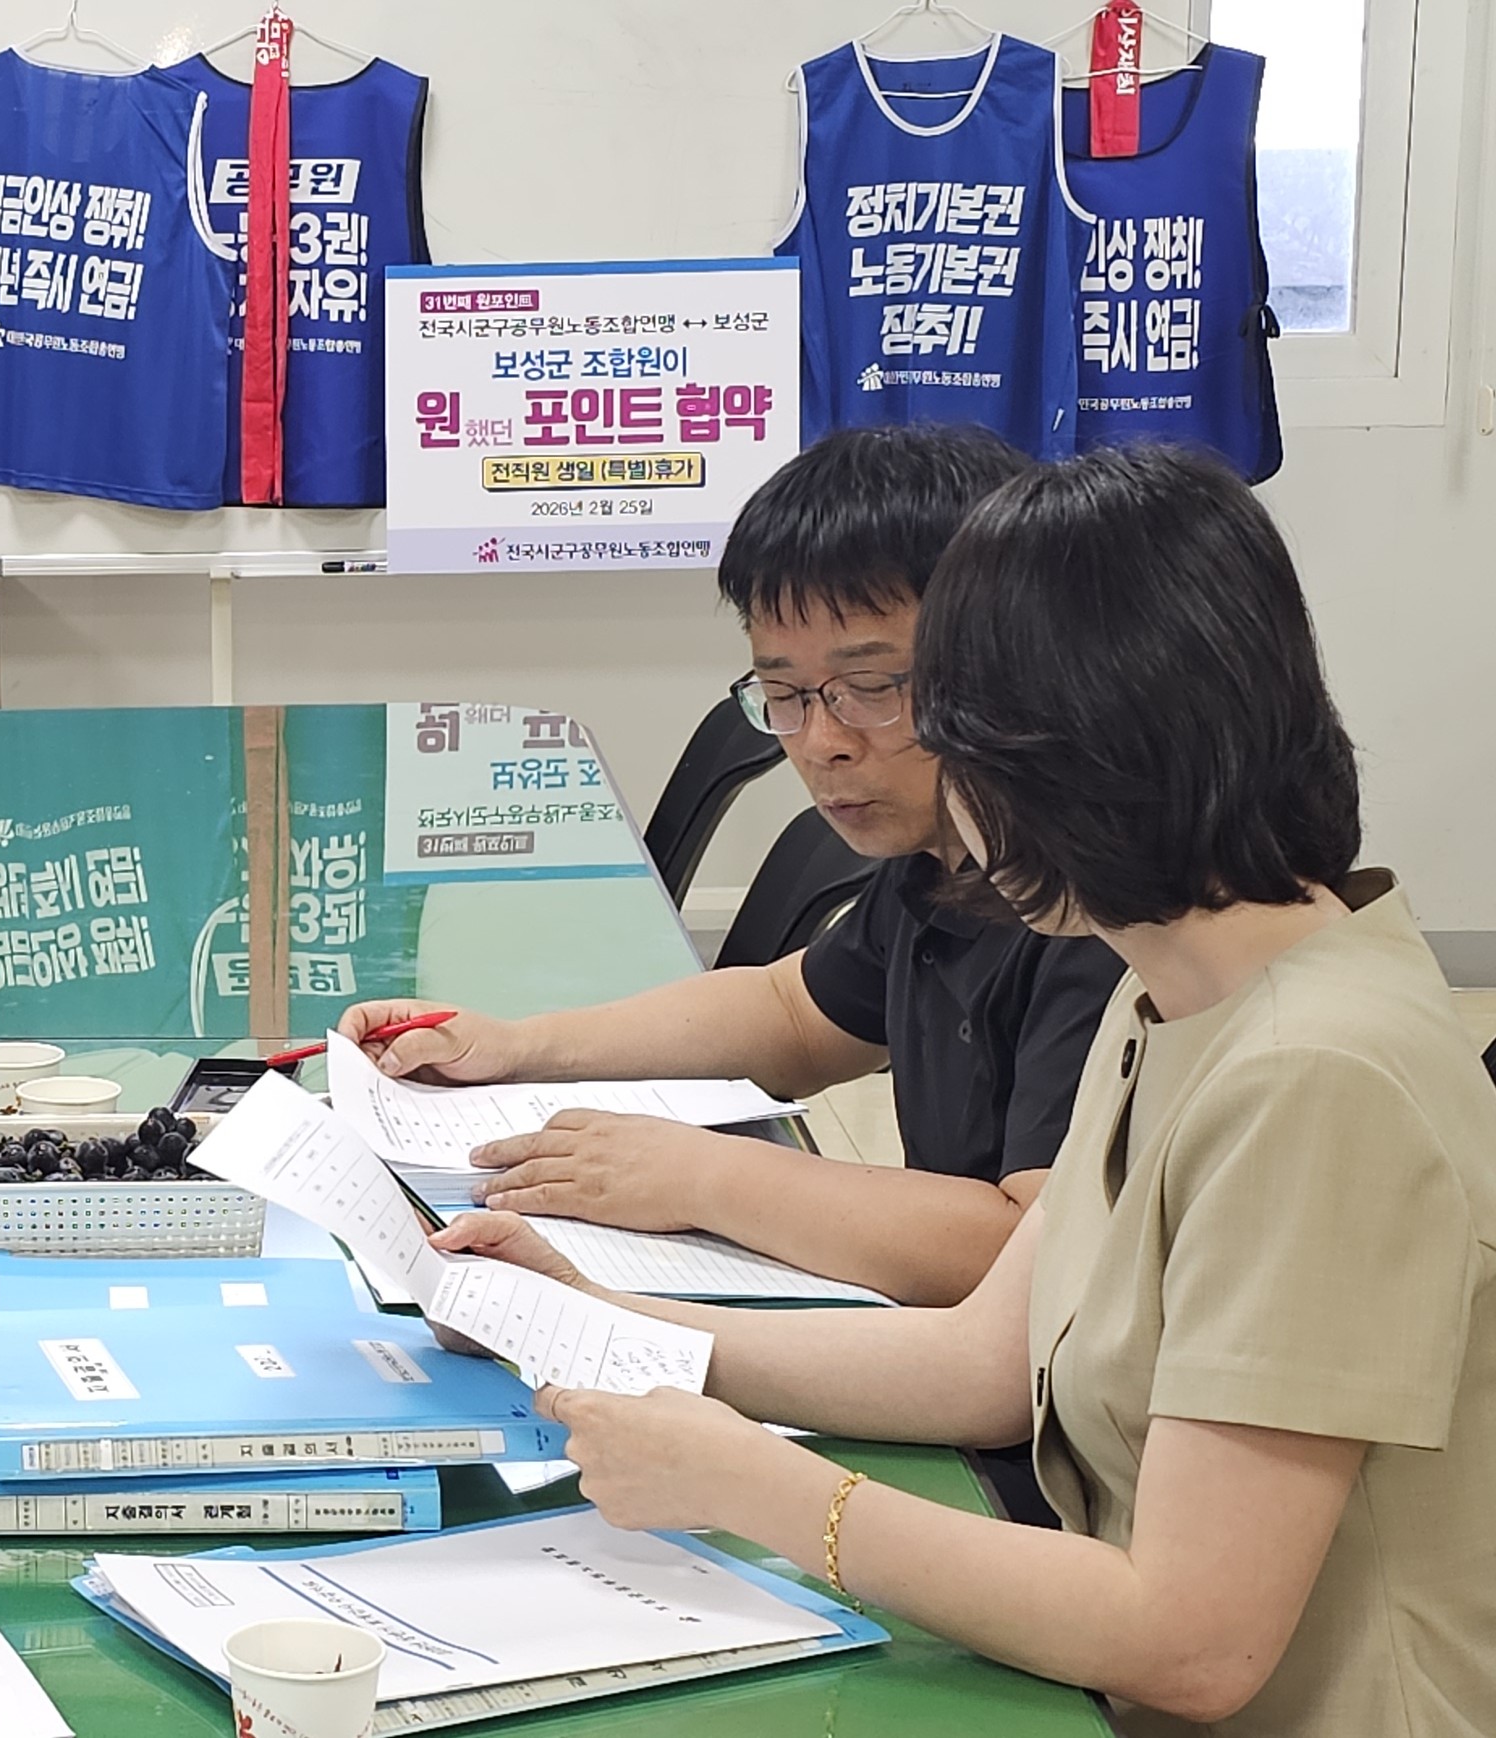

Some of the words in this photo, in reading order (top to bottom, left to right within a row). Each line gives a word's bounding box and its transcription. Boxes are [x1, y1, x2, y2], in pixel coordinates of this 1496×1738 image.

[83, 185, 152, 250] 쟁취!
[845, 182, 1027, 238] 정치기본권
[848, 243, 1022, 297] 노동기본권
[1143, 216, 1204, 290] 쟁취!
[21, 249, 78, 313] 즉시
[78, 255, 144, 320] 연금!
[288, 268, 368, 323] 자유!
[424, 294, 471, 311] 31번째
[418, 313, 676, 339] 전국시군구공무원노동조합연맹
[712, 312, 770, 332] 보성군
[880, 303, 984, 356] 쟁취!
[1082, 300, 1138, 373] 즉시
[1146, 298, 1201, 372] 연금!
[492, 350, 573, 381] 보성군
[580, 346, 688, 379] 조합원이
[524, 387, 664, 447] 포인트
[675, 382, 773, 443] 협약
[491, 461, 551, 483] 전직원
[556, 460, 595, 482] 생일
[531, 501, 583, 517] 2026년
[589, 500, 613, 517] 2월
[620, 499, 653, 516] 25일
